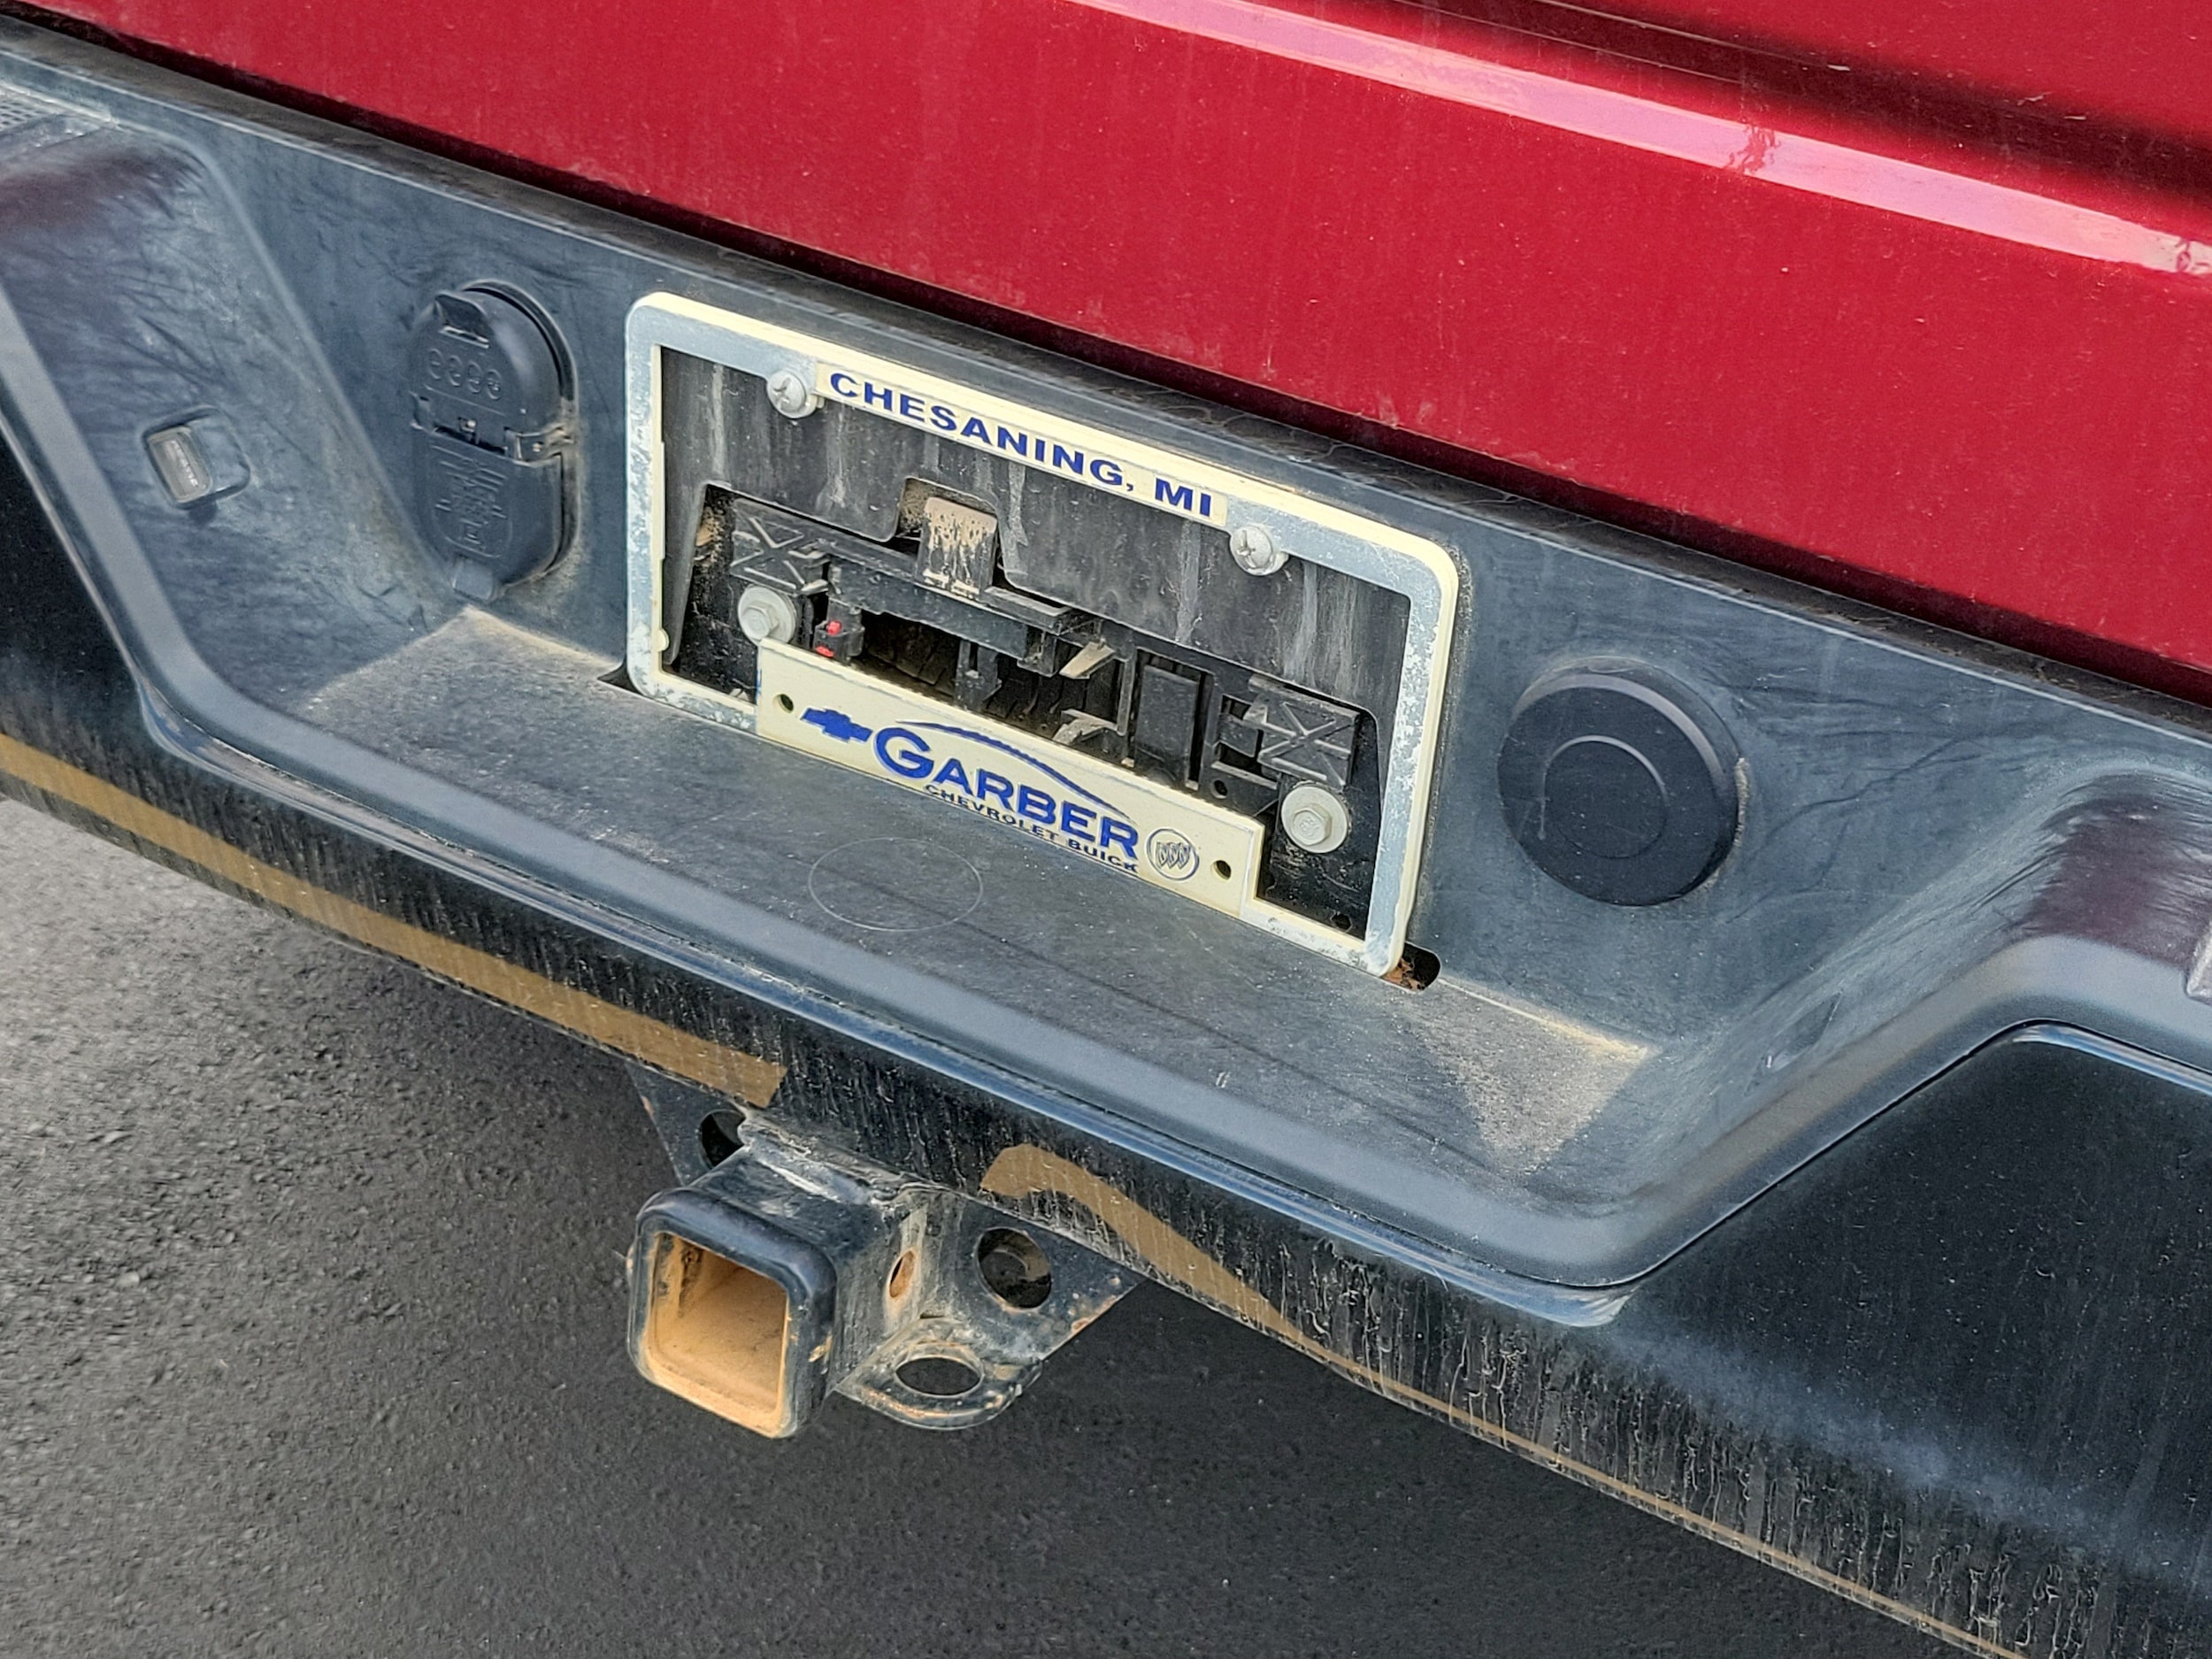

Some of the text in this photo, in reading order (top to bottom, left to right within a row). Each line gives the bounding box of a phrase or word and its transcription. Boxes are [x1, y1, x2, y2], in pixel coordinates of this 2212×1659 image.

[830, 373, 1212, 517] CHESANING, MI
[873, 726, 1138, 859] GARBER
[926, 784, 1138, 873] CHEVROLET BUICK
